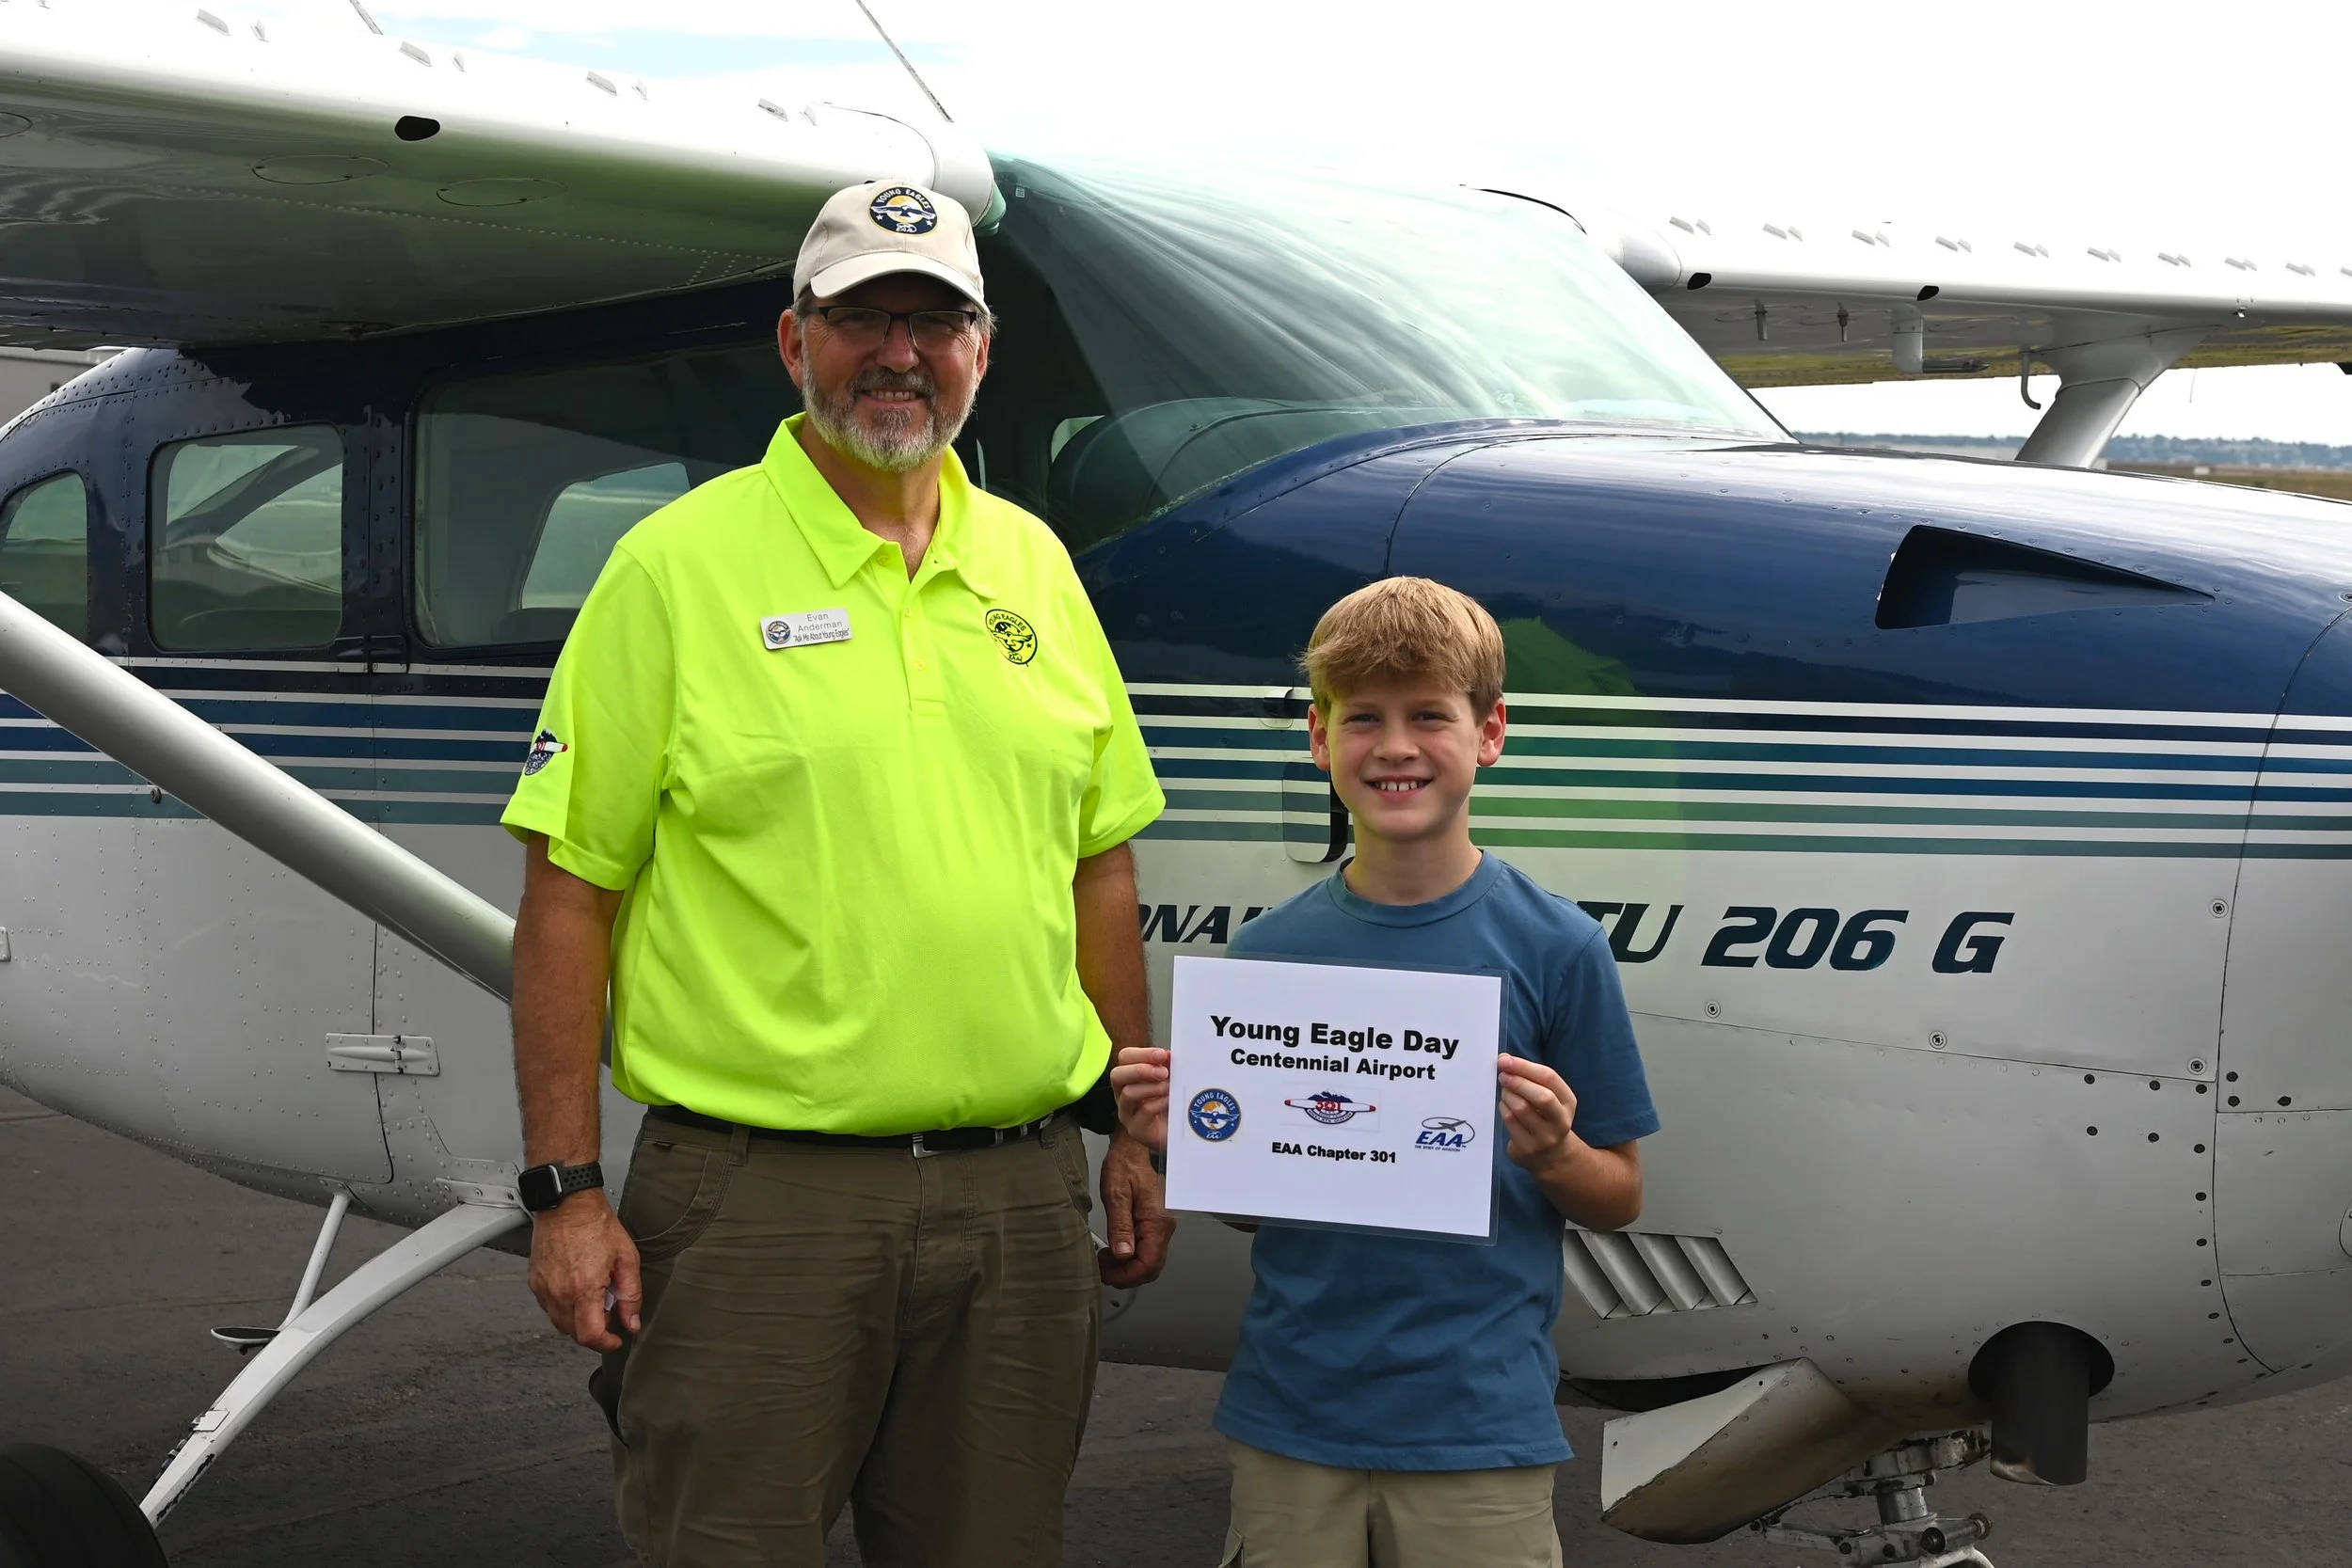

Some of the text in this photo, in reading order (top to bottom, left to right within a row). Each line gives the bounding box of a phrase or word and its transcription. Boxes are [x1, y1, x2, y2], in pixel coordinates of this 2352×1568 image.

[876, 188, 931, 210] YOUNG EAGLES
[798, 621, 843, 632] Anderman
[806, 613, 829, 622] Evan
[1577, 901, 1684, 963] TU
[1701, 906, 1909, 971] 206
[1931, 911, 2015, 974] G
[1210, 1015, 1459, 1060] Young Eagle Day
[1231, 1049, 1436, 1080] Centennial Airport
[1194, 1092, 1236, 1111] YOUNG EAGLES
[1315, 1101, 1342, 1112] 301
[1416, 1131, 1463, 1148] EAA
[1272, 1141, 1396, 1163] EAA Chapter 301
